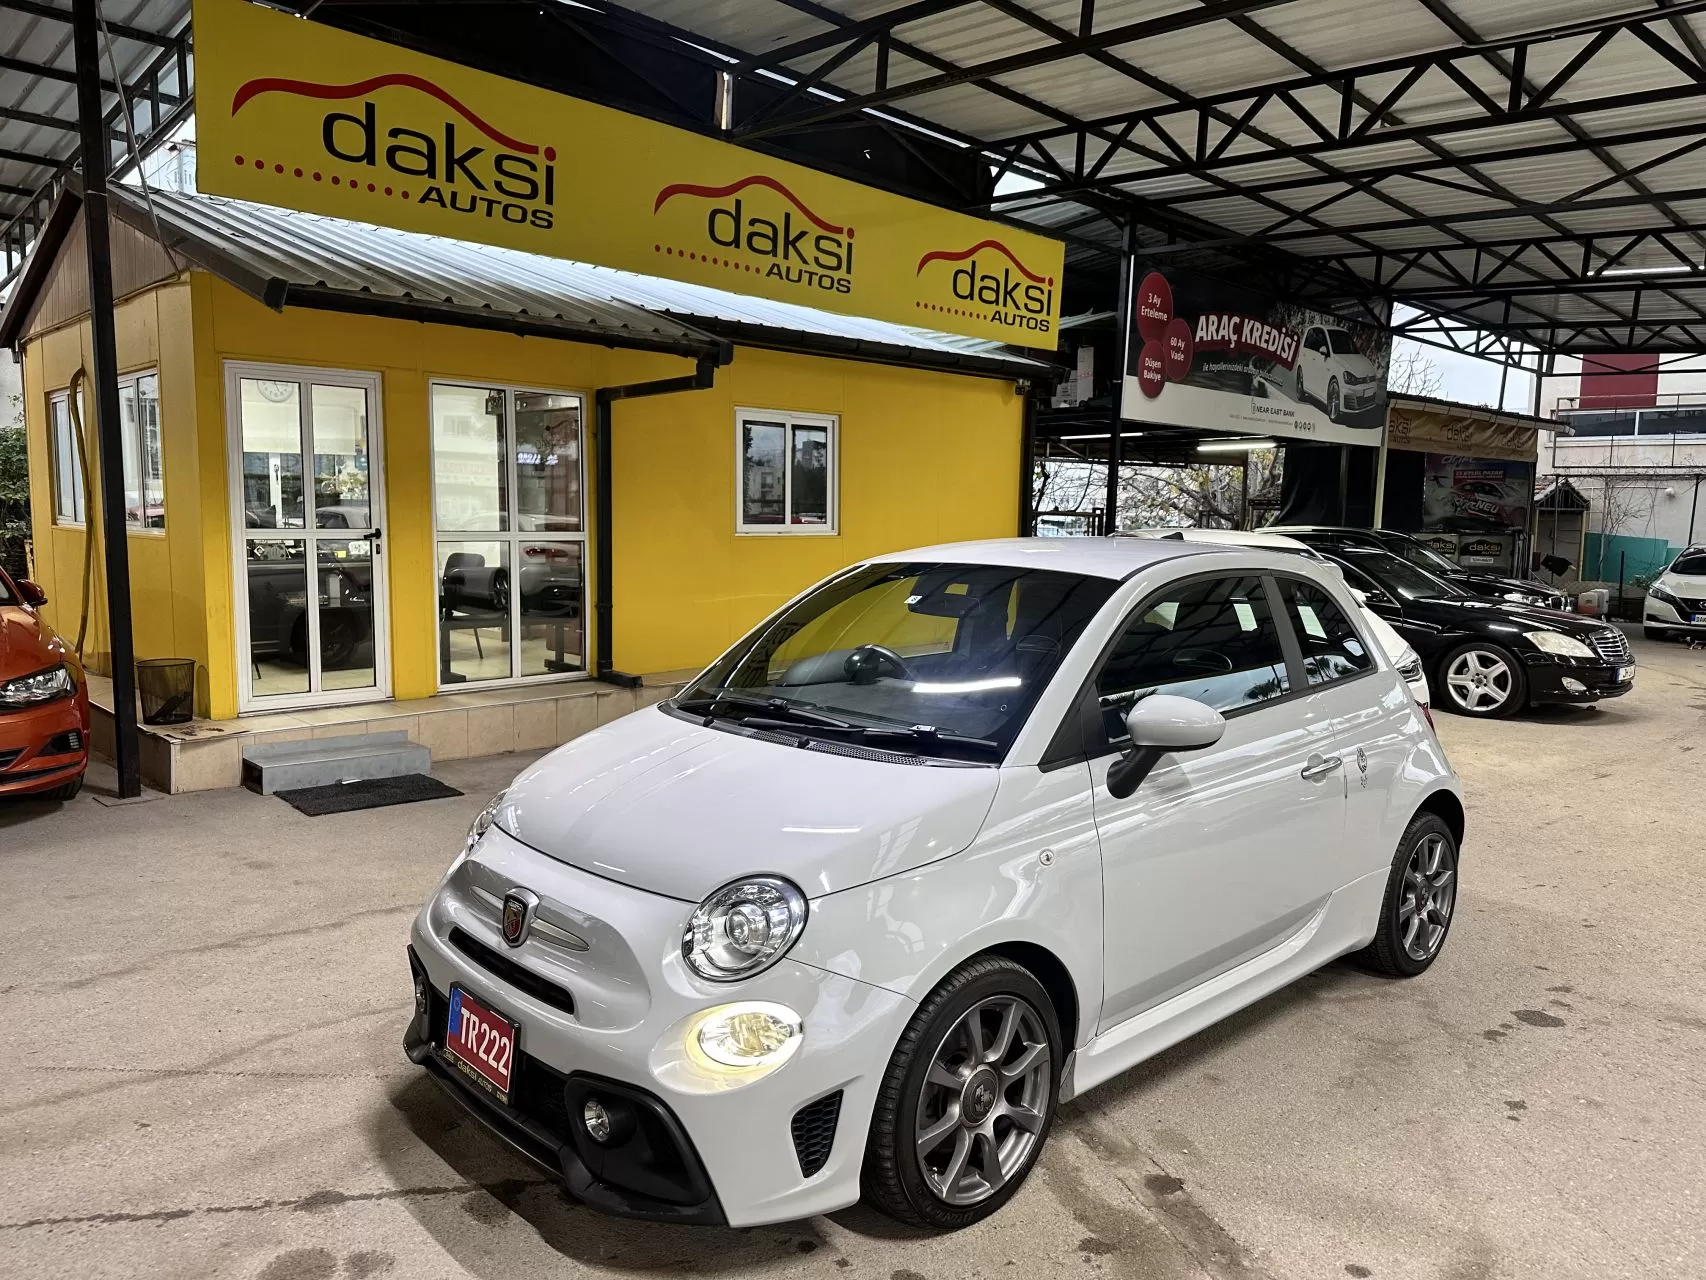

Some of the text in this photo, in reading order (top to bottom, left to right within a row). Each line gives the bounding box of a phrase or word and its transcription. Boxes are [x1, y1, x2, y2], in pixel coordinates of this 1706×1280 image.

[322, 101, 557, 206] daksi
[418, 185, 554, 230] AUTOS
[707, 198, 855, 275] daksi
[765, 263, 851, 294] AUTOS
[952, 260, 1054, 317] daksi
[1148, 293, 1161, 307] 3 Ay
[990, 311, 1050, 333] AUTOS
[1141, 305, 1168, 321] Erteleme
[1170, 336, 1185, 351] 60 Ay
[1194, 314, 1298, 363] ARAÇ KREDİSİ
[1144, 357, 1162, 369] Düşen
[1170, 349, 1185, 361] Vade
[1143, 369, 1161, 382] Bakiye
[1256, 406, 1270, 414] NEAR
[1270, 407, 1283, 416] EAST
[1388, 415, 1412, 437] aksi
[1469, 543, 1501, 551] daksi
[460, 1006, 510, 1077] TR222
[457, 1060, 478, 1081] daksi
